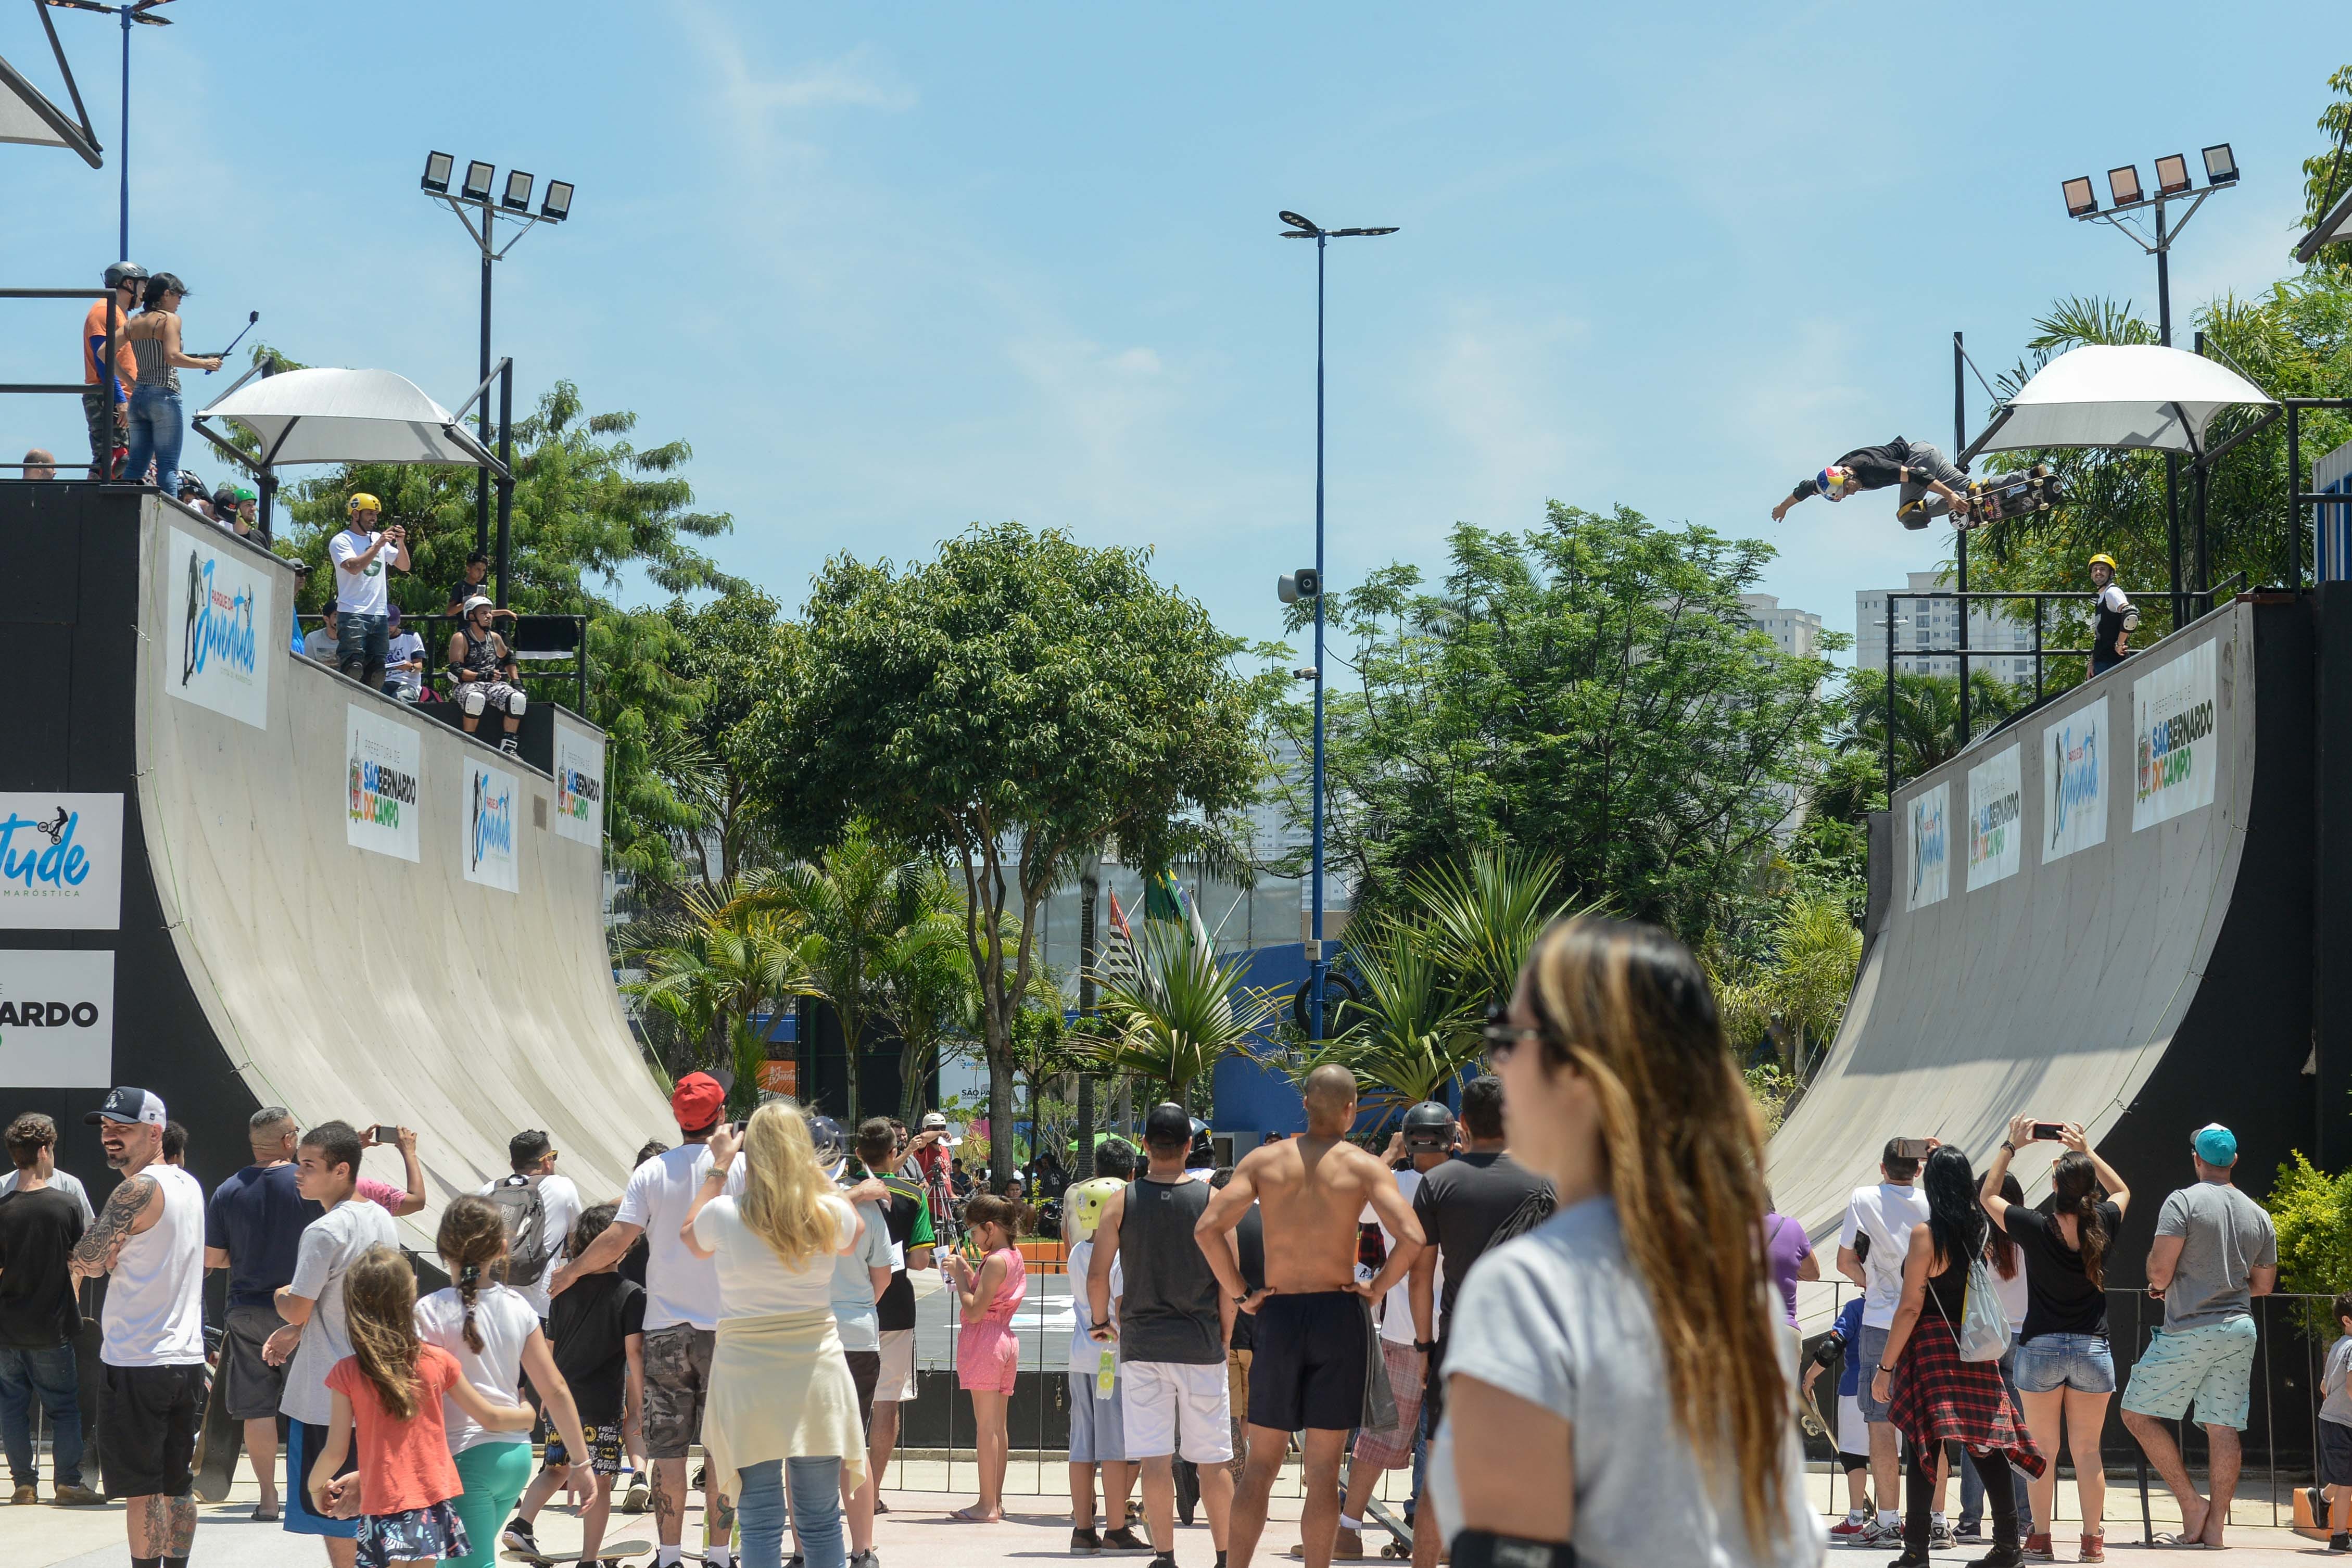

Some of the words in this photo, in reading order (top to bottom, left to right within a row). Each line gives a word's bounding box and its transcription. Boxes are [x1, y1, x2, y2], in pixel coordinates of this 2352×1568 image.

[195, 559, 255, 676] Juventude
[4, 889, 80, 897] MARÓSTICA
[0, 1001, 98, 1028] ARDO
[962, 1088, 979, 1096] SÃO
